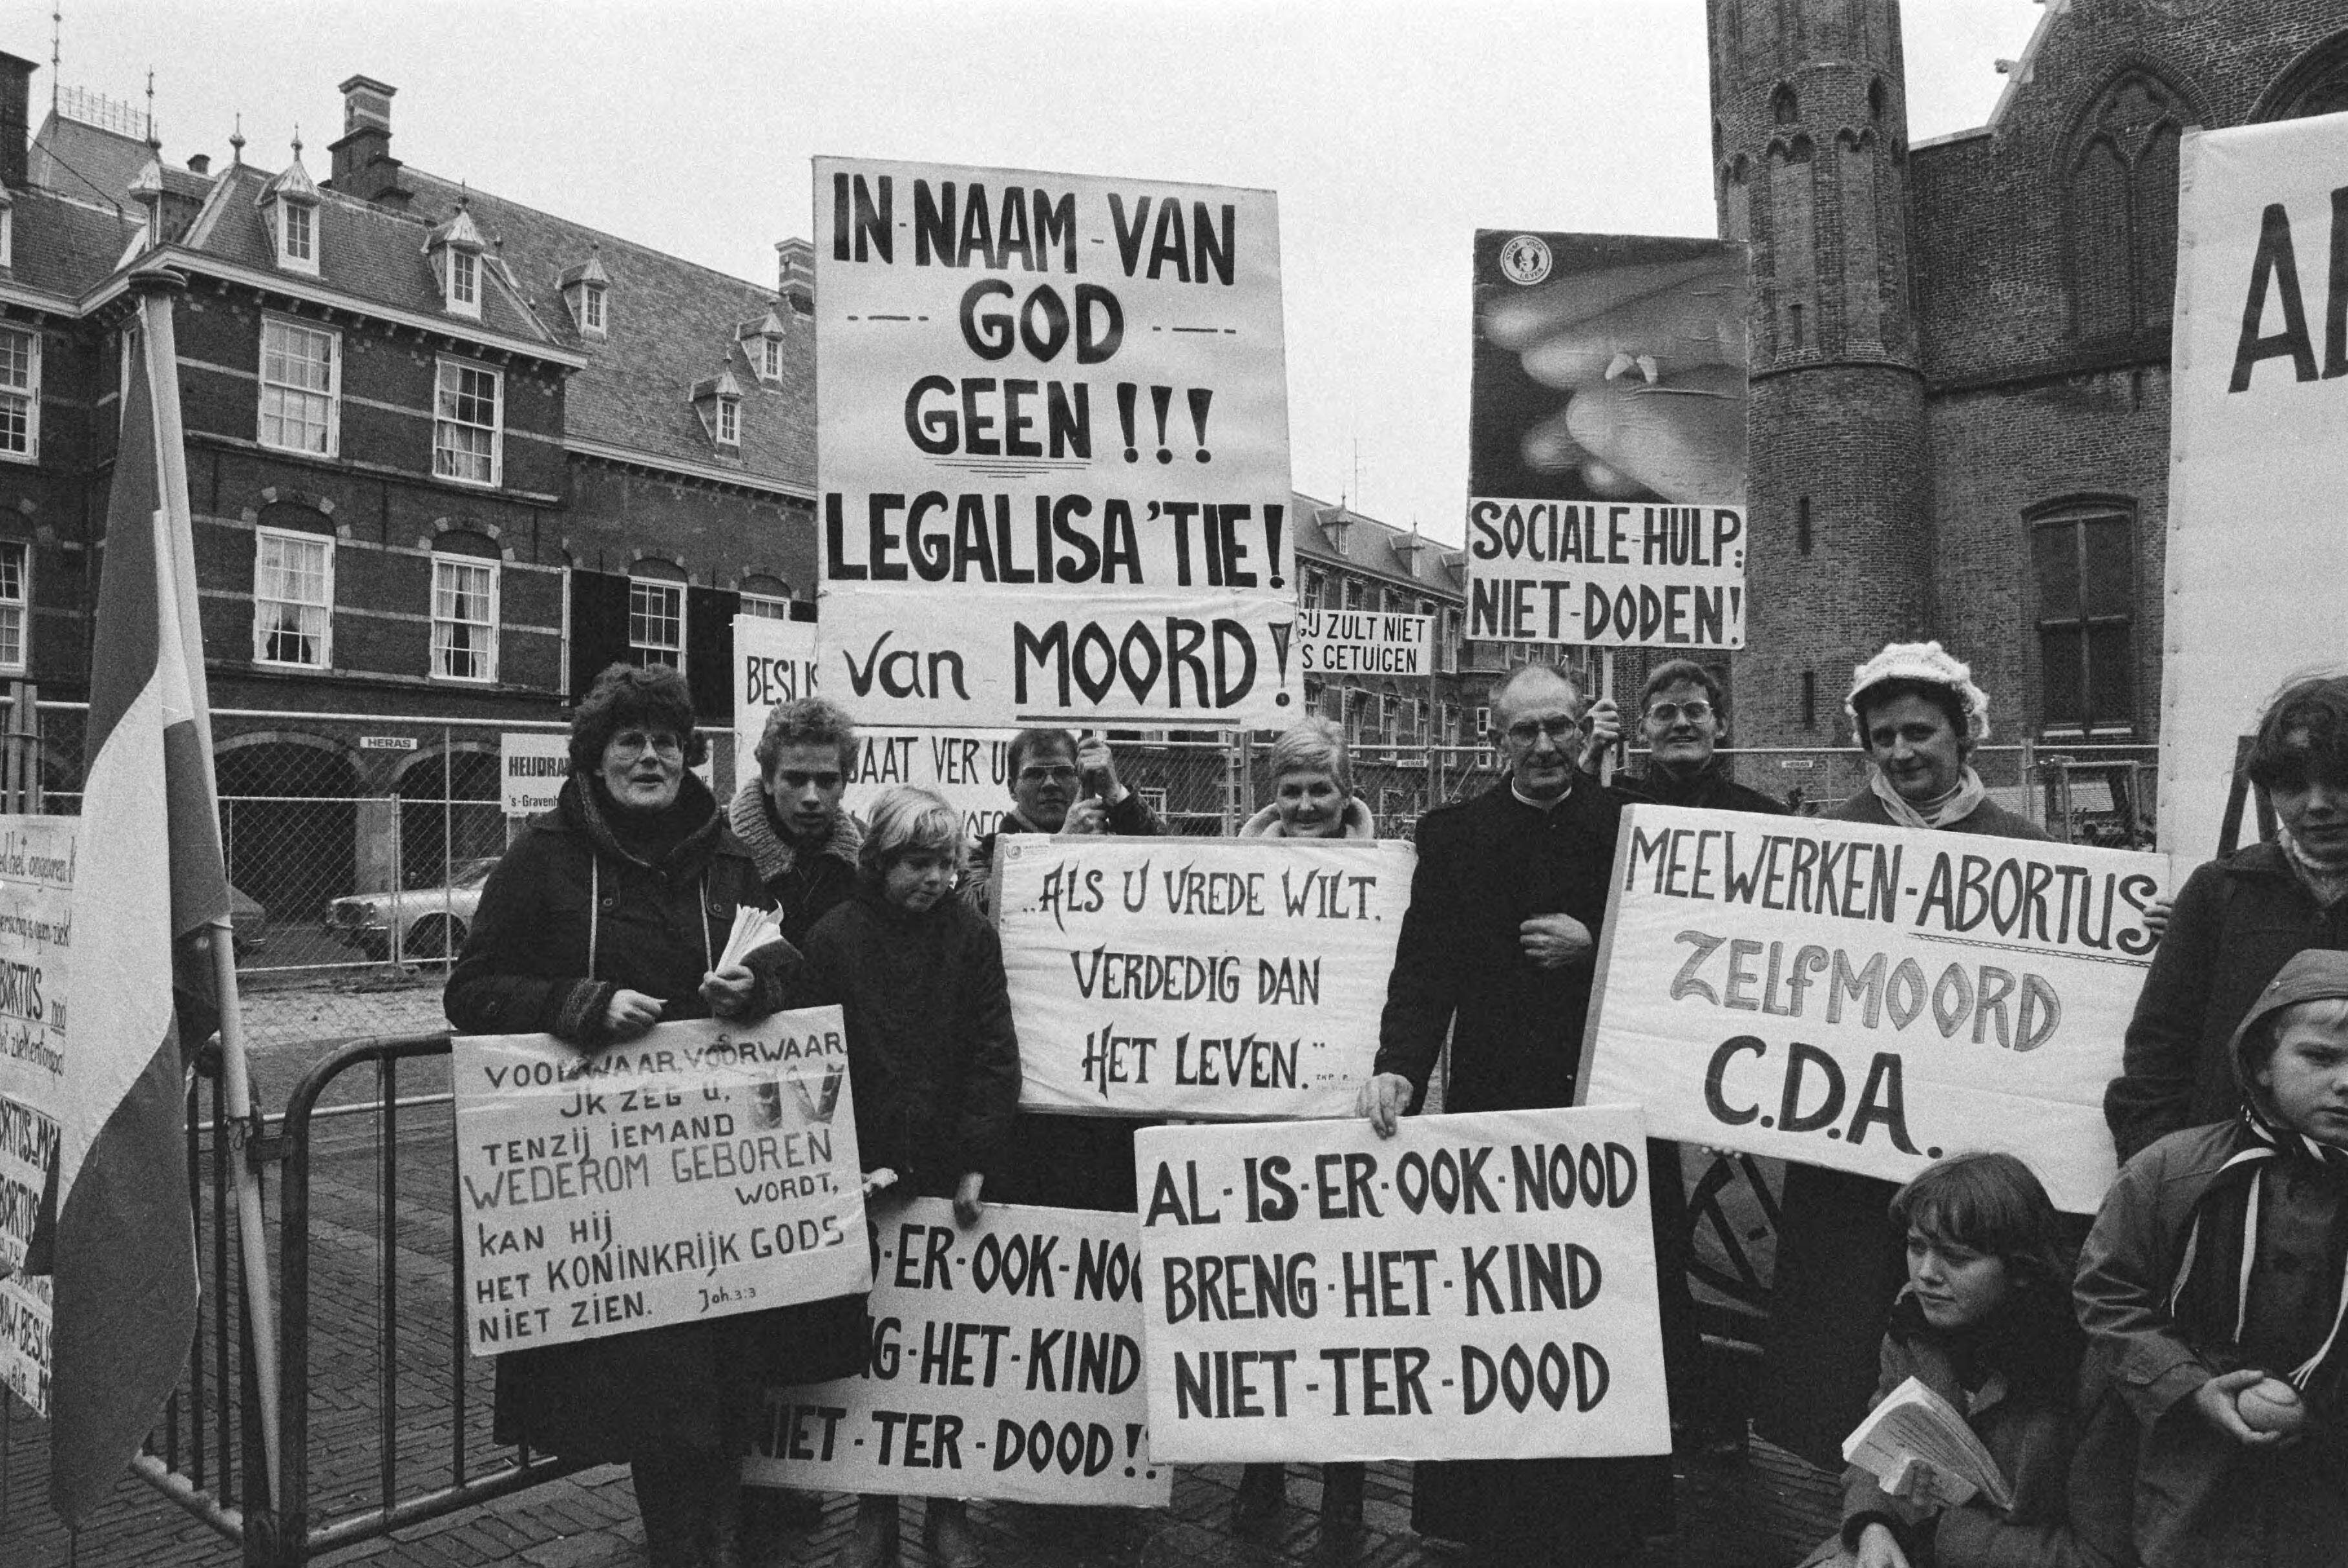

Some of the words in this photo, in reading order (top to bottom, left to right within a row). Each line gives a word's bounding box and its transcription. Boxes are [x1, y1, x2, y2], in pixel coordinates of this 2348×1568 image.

[960, 278, 1124, 364] GOD
[1326, 614, 1377, 640] ZULT
[843, 631, 971, 701] van
[368, 738, 411, 747] HERAS
[932, 737, 980, 784] VER
[1124, 858, 1149, 912] U
[1163, 859, 1264, 917] VREDE
[1071, 943, 1239, 1004] VERDEDIG
[1257, 956, 1321, 1005] DAN
[1082, 1021, 1157, 1100] HET
[463, 1153, 649, 1211] WEDEROM
[672, 1129, 832, 1182] GEBOREN
[735, 1171, 839, 1206] WORDT,
[476, 1273, 530, 1304] HET
[751, 1215, 844, 1260] GODS
